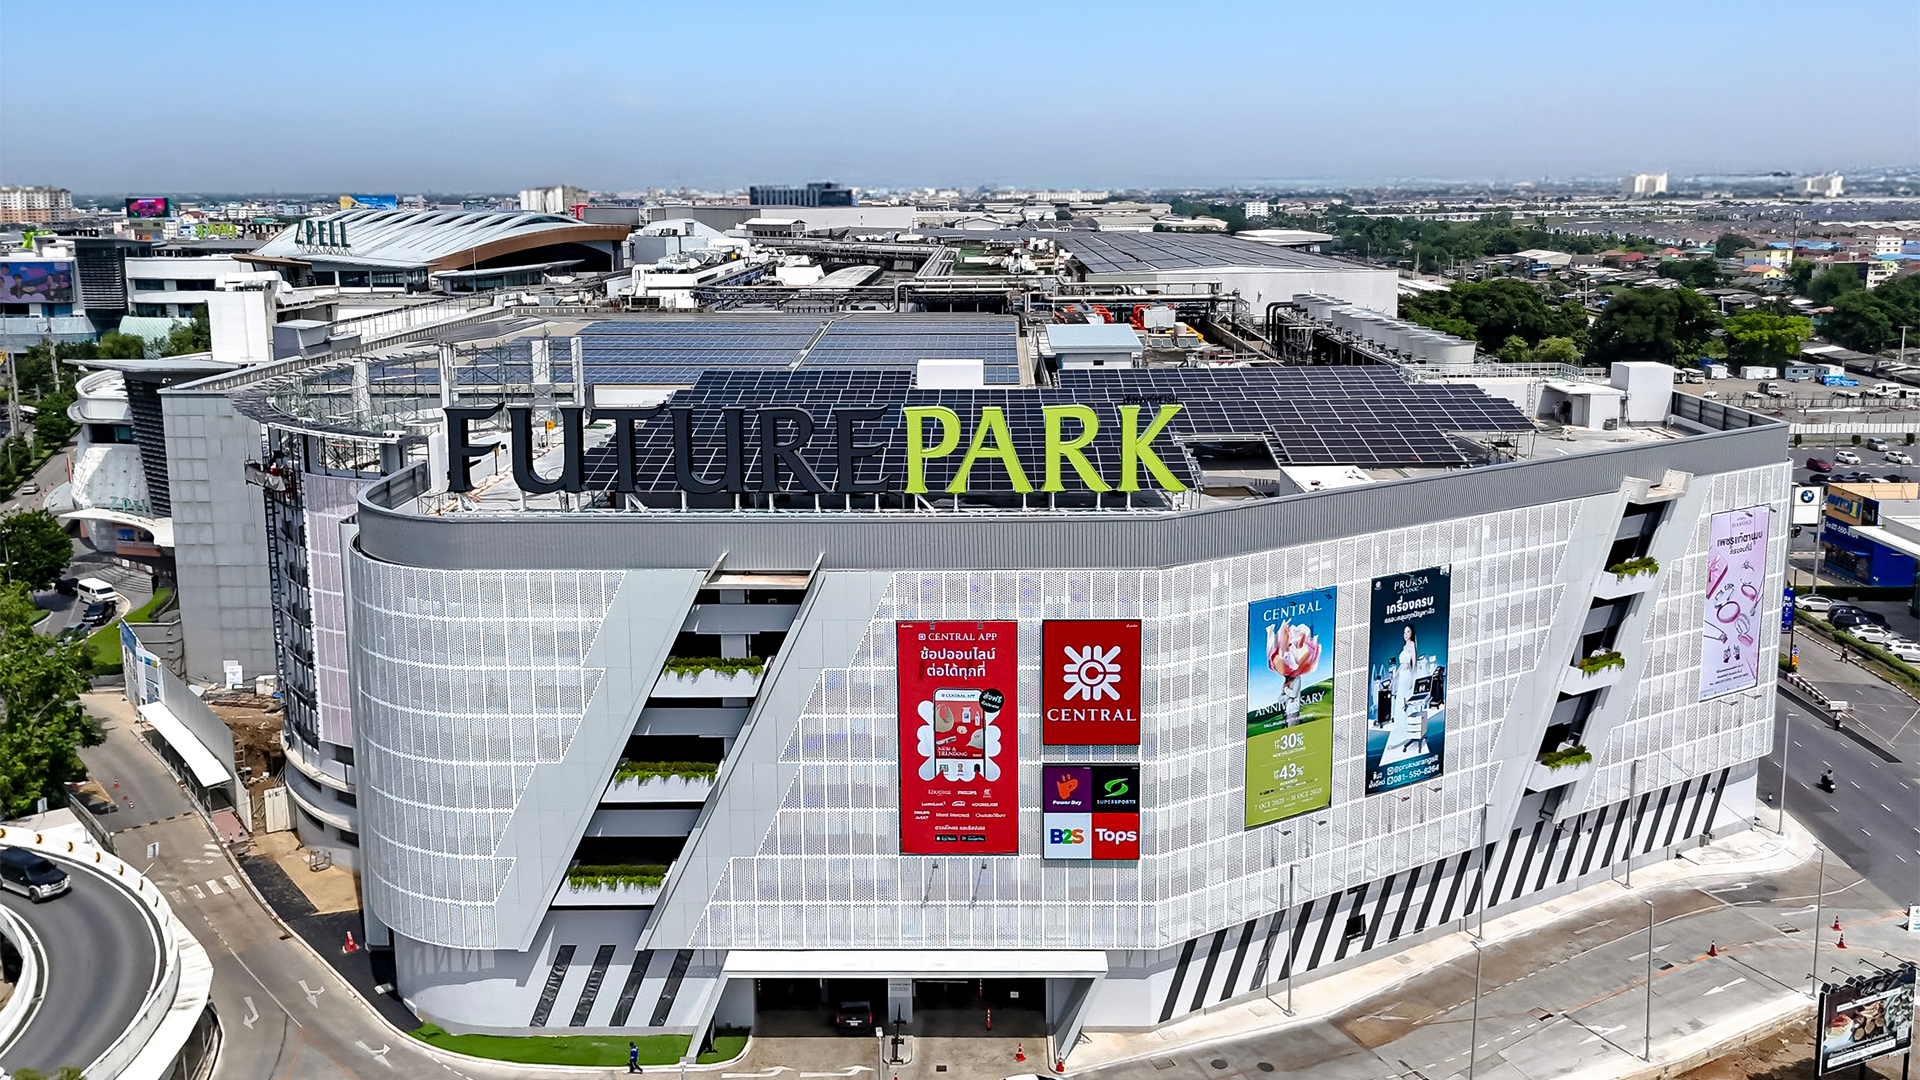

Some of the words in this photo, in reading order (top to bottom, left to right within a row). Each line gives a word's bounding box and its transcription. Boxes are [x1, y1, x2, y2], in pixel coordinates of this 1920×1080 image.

[445, 401, 890, 494] FUTURE
[904, 403, 1188, 494] PARK
[1263, 600, 1323, 621] CENTRAL
[1386, 595, 1434, 615] เครื่องครบ
[928, 632, 975, 641] CENTRAL
[977, 632, 997, 641] APP
[920, 646, 996, 660] ช้อปออนไลน์
[926, 661, 986, 680] ต่อได้ทุกที่
[1046, 708, 1137, 721] CENTRAL
[1050, 828, 1085, 844] B2S
[1094, 828, 1137, 845] Tops
